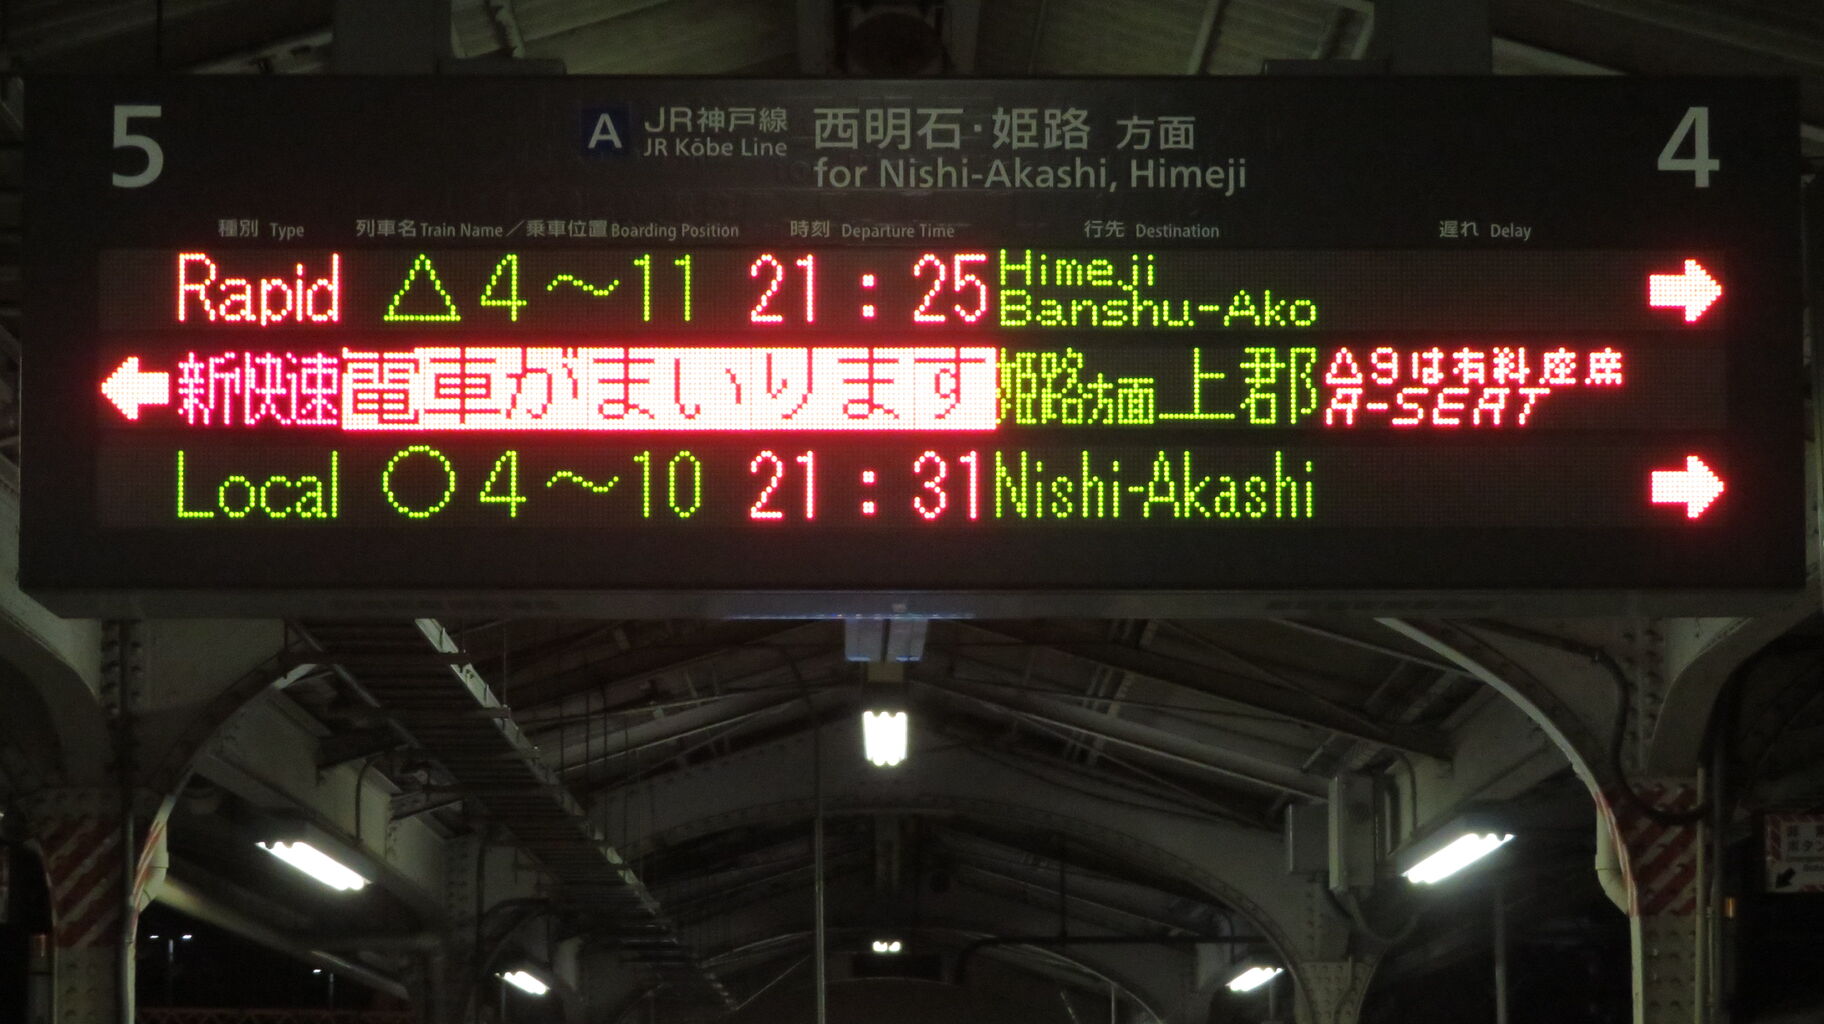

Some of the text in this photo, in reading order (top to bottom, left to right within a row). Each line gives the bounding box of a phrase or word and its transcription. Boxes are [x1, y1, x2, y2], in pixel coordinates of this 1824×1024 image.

[589, 113, 622, 148] A
[645, 107, 787, 132] JR神戸線
[1116, 115, 1196, 150] 方面
[113, 106, 163, 187] 5
[643, 137, 787, 156] JR Kōbe Line
[1657, 107, 1720, 187] 4
[814, 156, 1246, 197] for Nishi-Akashi, Himeji
[218, 219, 305, 241] 種別 Type
[356, 219, 417, 237] 列車名
[421, 222, 456, 237] Train
[460, 223, 503, 237] Name
[611, 222, 677, 241] Boarding
[681, 222, 739, 237] Position
[790, 219, 955, 241] 時刻 Departure Time
[1084, 220, 1220, 239] 行先 Destination
[1439, 220, 1532, 241] 遅れ Delay
[1000, 249, 1154, 289] Himeji
[178, 252, 338, 326] Rapid
[1000, 289, 1317, 326] Banshu-Ako
[178, 351, 338, 426] 新快速
[343, 348, 993, 429] 電車がまいります
[1326, 387, 1550, 424] A-SEAT
[177, 451, 338, 518] Local
[996, 450, 1313, 518] Nishi-Akashi
